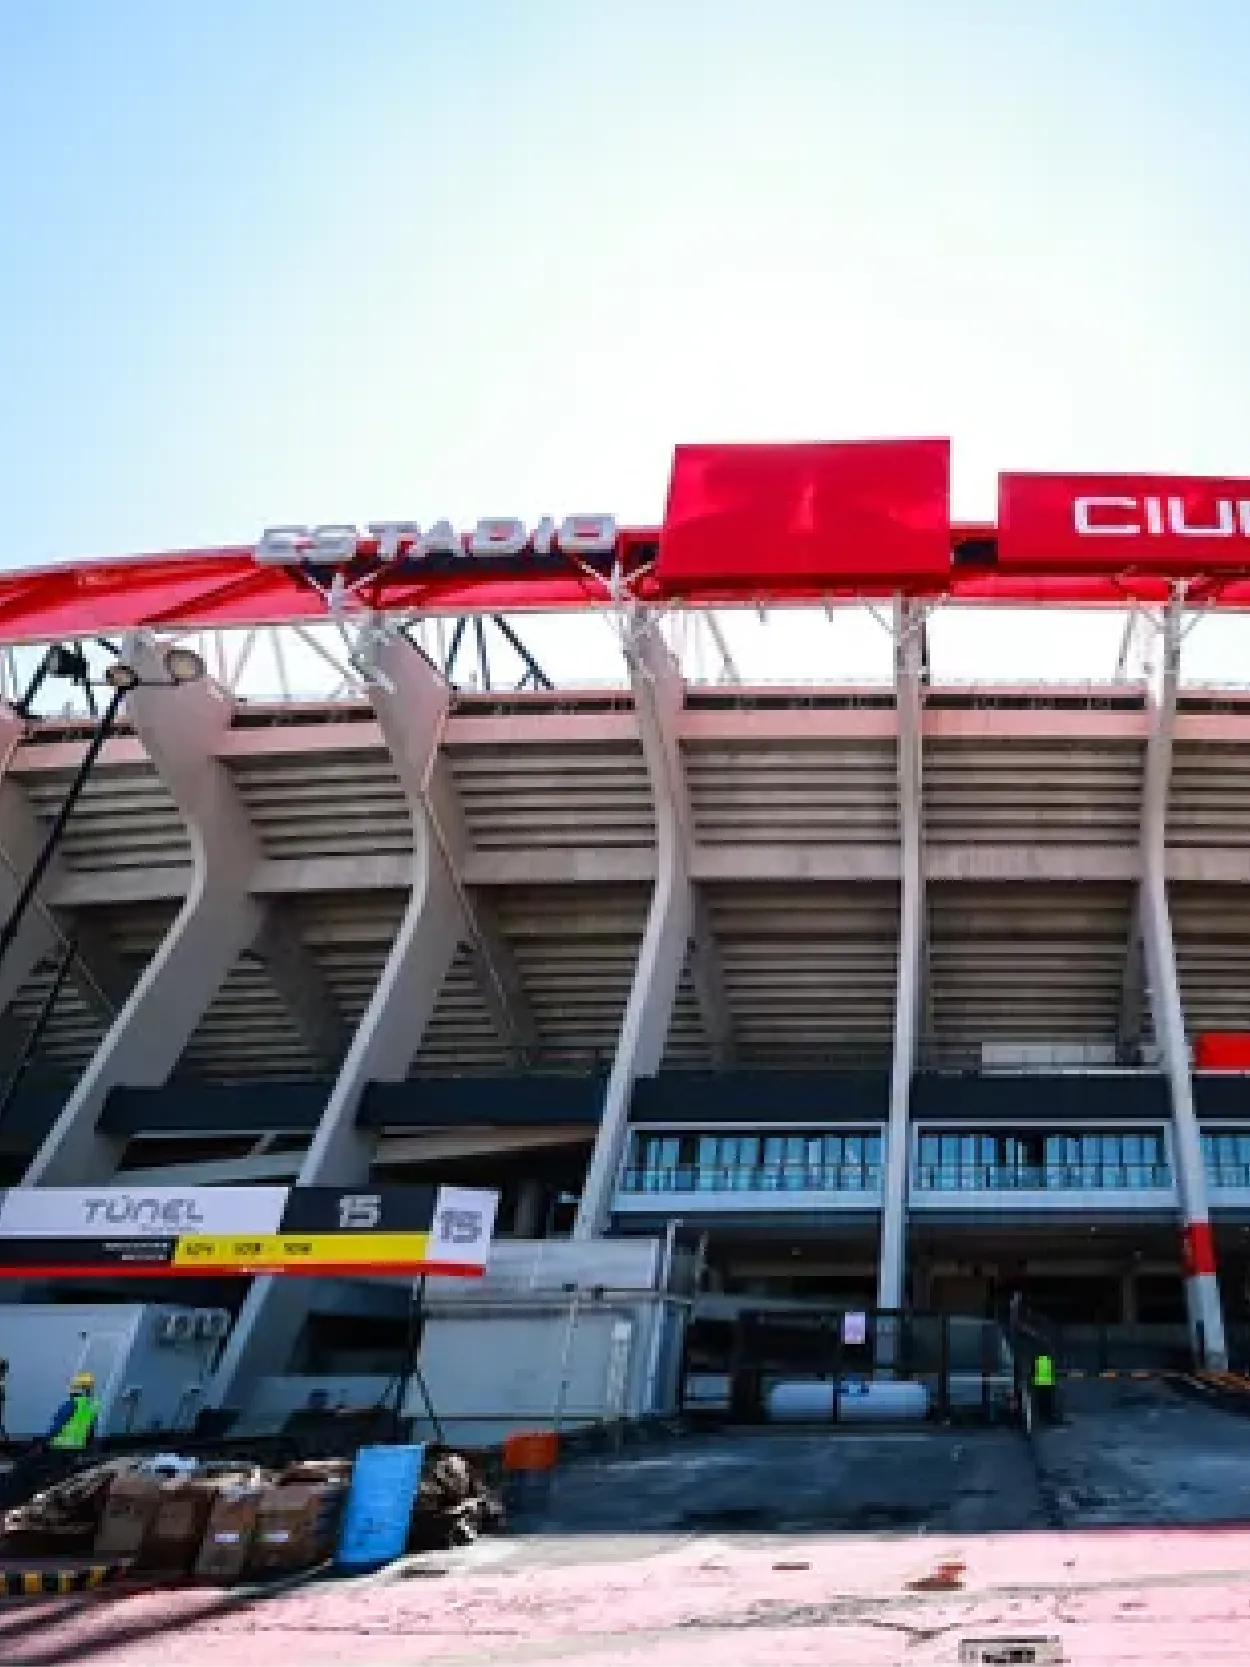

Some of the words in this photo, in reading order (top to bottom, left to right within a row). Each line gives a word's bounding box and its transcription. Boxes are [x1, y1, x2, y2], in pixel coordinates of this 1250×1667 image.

[256, 514, 615, 564] ESTADIO
[340, 1195, 381, 1227] 15
[440, 1208, 482, 1243] 15
